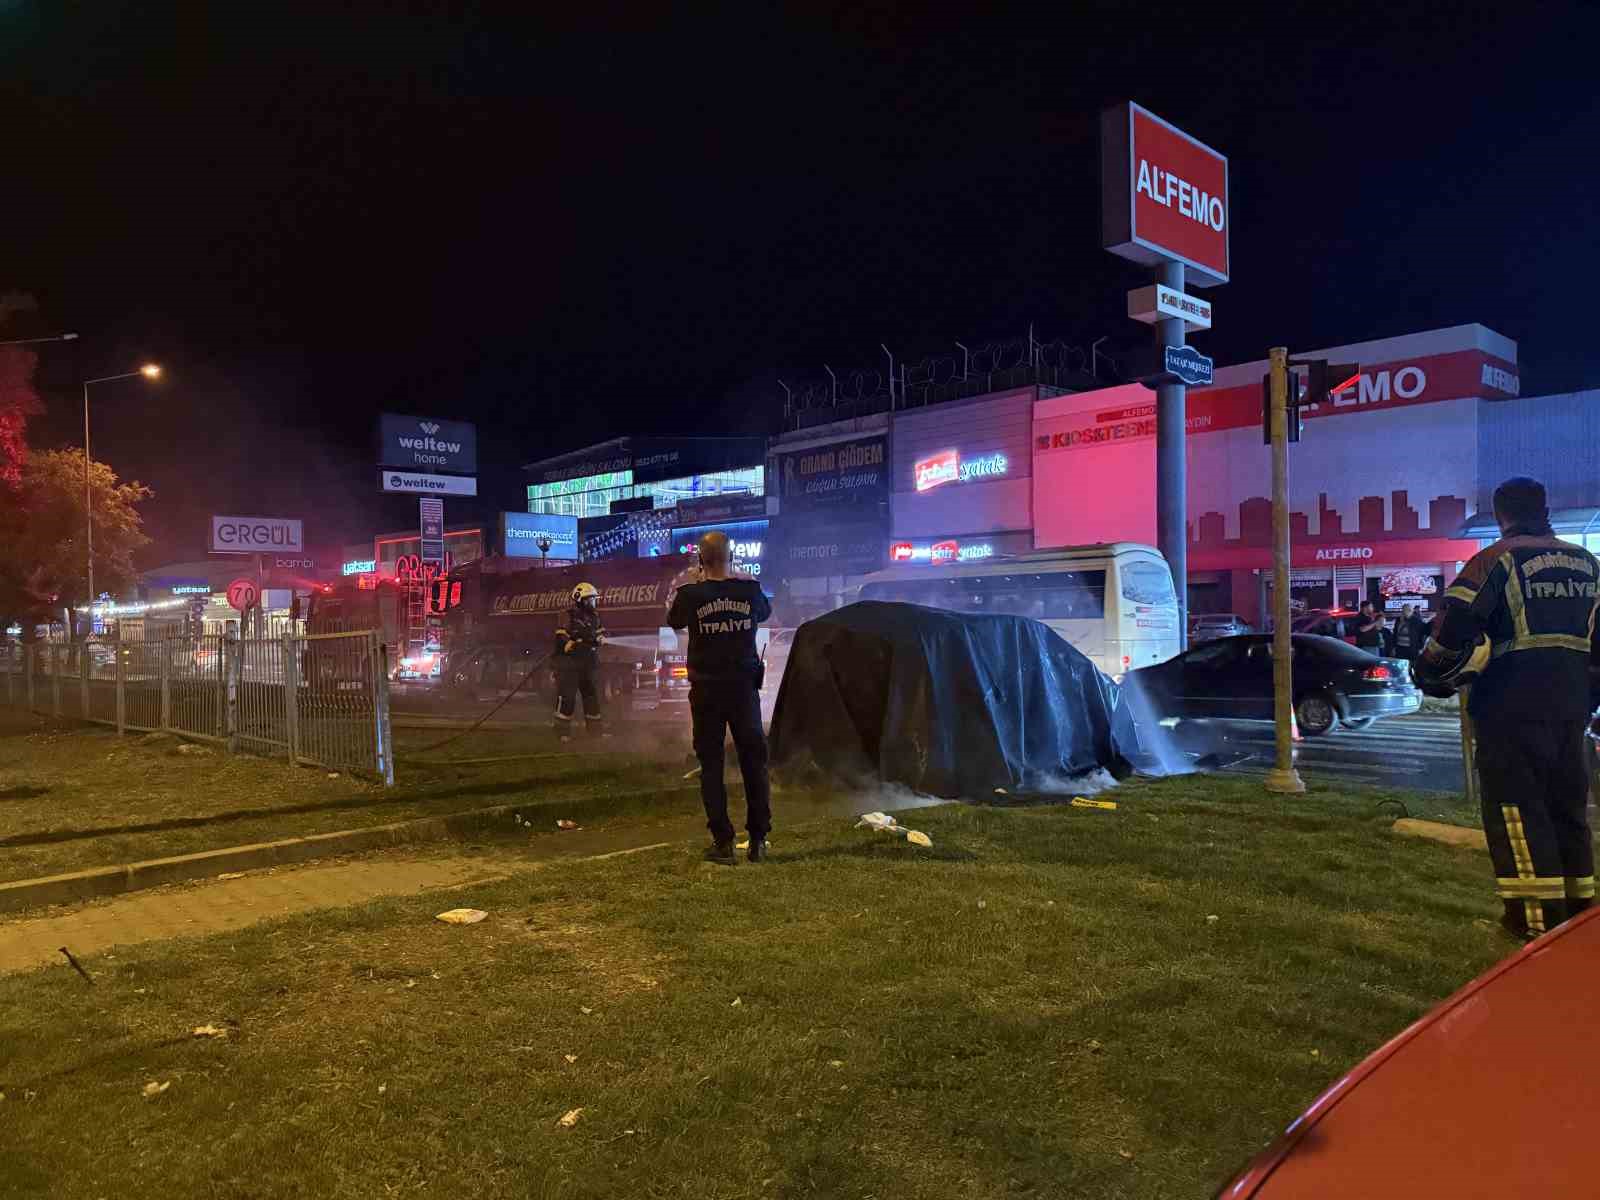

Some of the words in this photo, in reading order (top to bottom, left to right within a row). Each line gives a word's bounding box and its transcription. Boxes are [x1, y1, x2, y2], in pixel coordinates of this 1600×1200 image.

[1122, 406, 1154, 419] ALFEMO
[398, 435, 461, 454] weltew
[413, 451, 448, 465] home
[959, 456, 1006, 481] yatak
[403, 478, 446, 489] weltew
[1315, 547, 1373, 561] ALFEMO
[231, 586, 256, 604] 70
